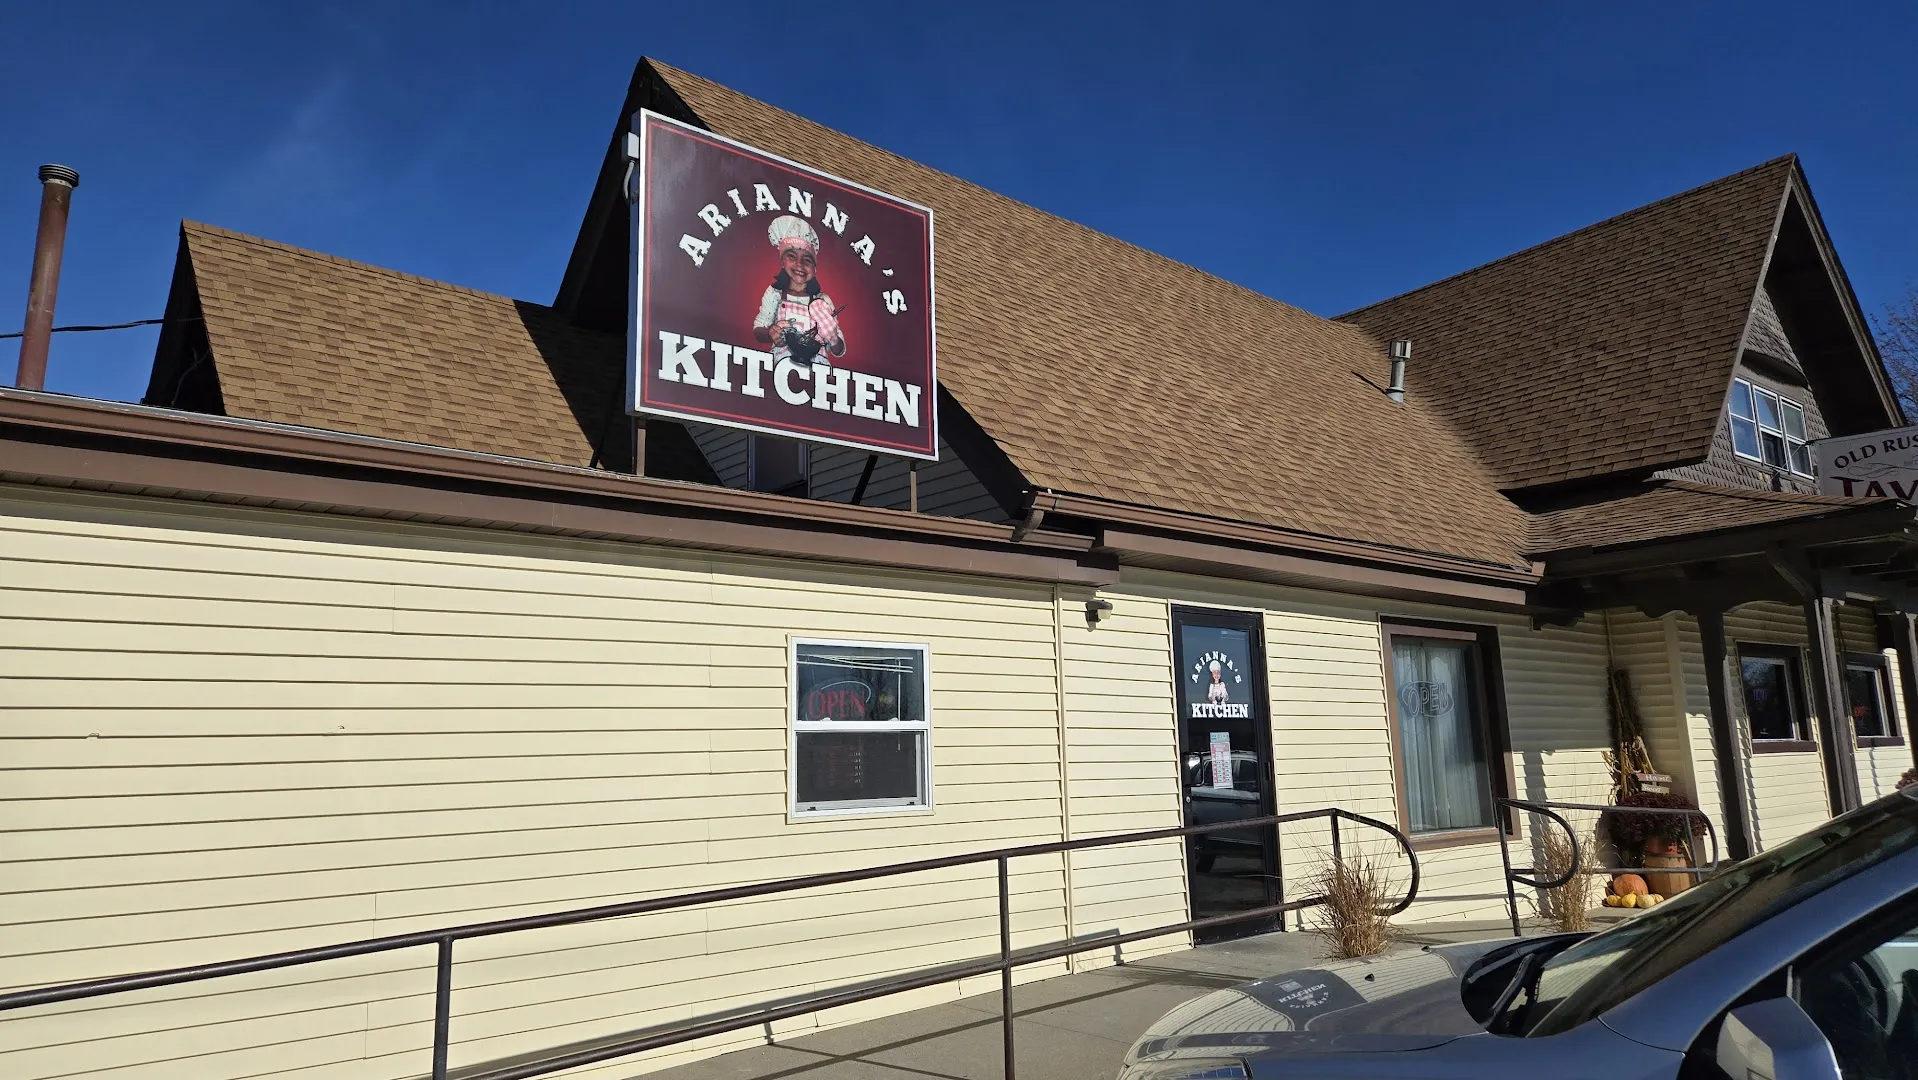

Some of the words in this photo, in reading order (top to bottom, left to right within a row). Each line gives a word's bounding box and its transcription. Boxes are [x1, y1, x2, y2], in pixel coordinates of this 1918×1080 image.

[678, 183, 908, 315] ARIANNA'S
[658, 330, 922, 428] KITCHEN
[1834, 444, 1877, 469] OLD
[1191, 651, 1242, 684] ARIANNA'S
[807, 689, 866, 718] OPEN
[1191, 703, 1249, 719] KITCHEN
[1408, 682, 1449, 717] OPEN
